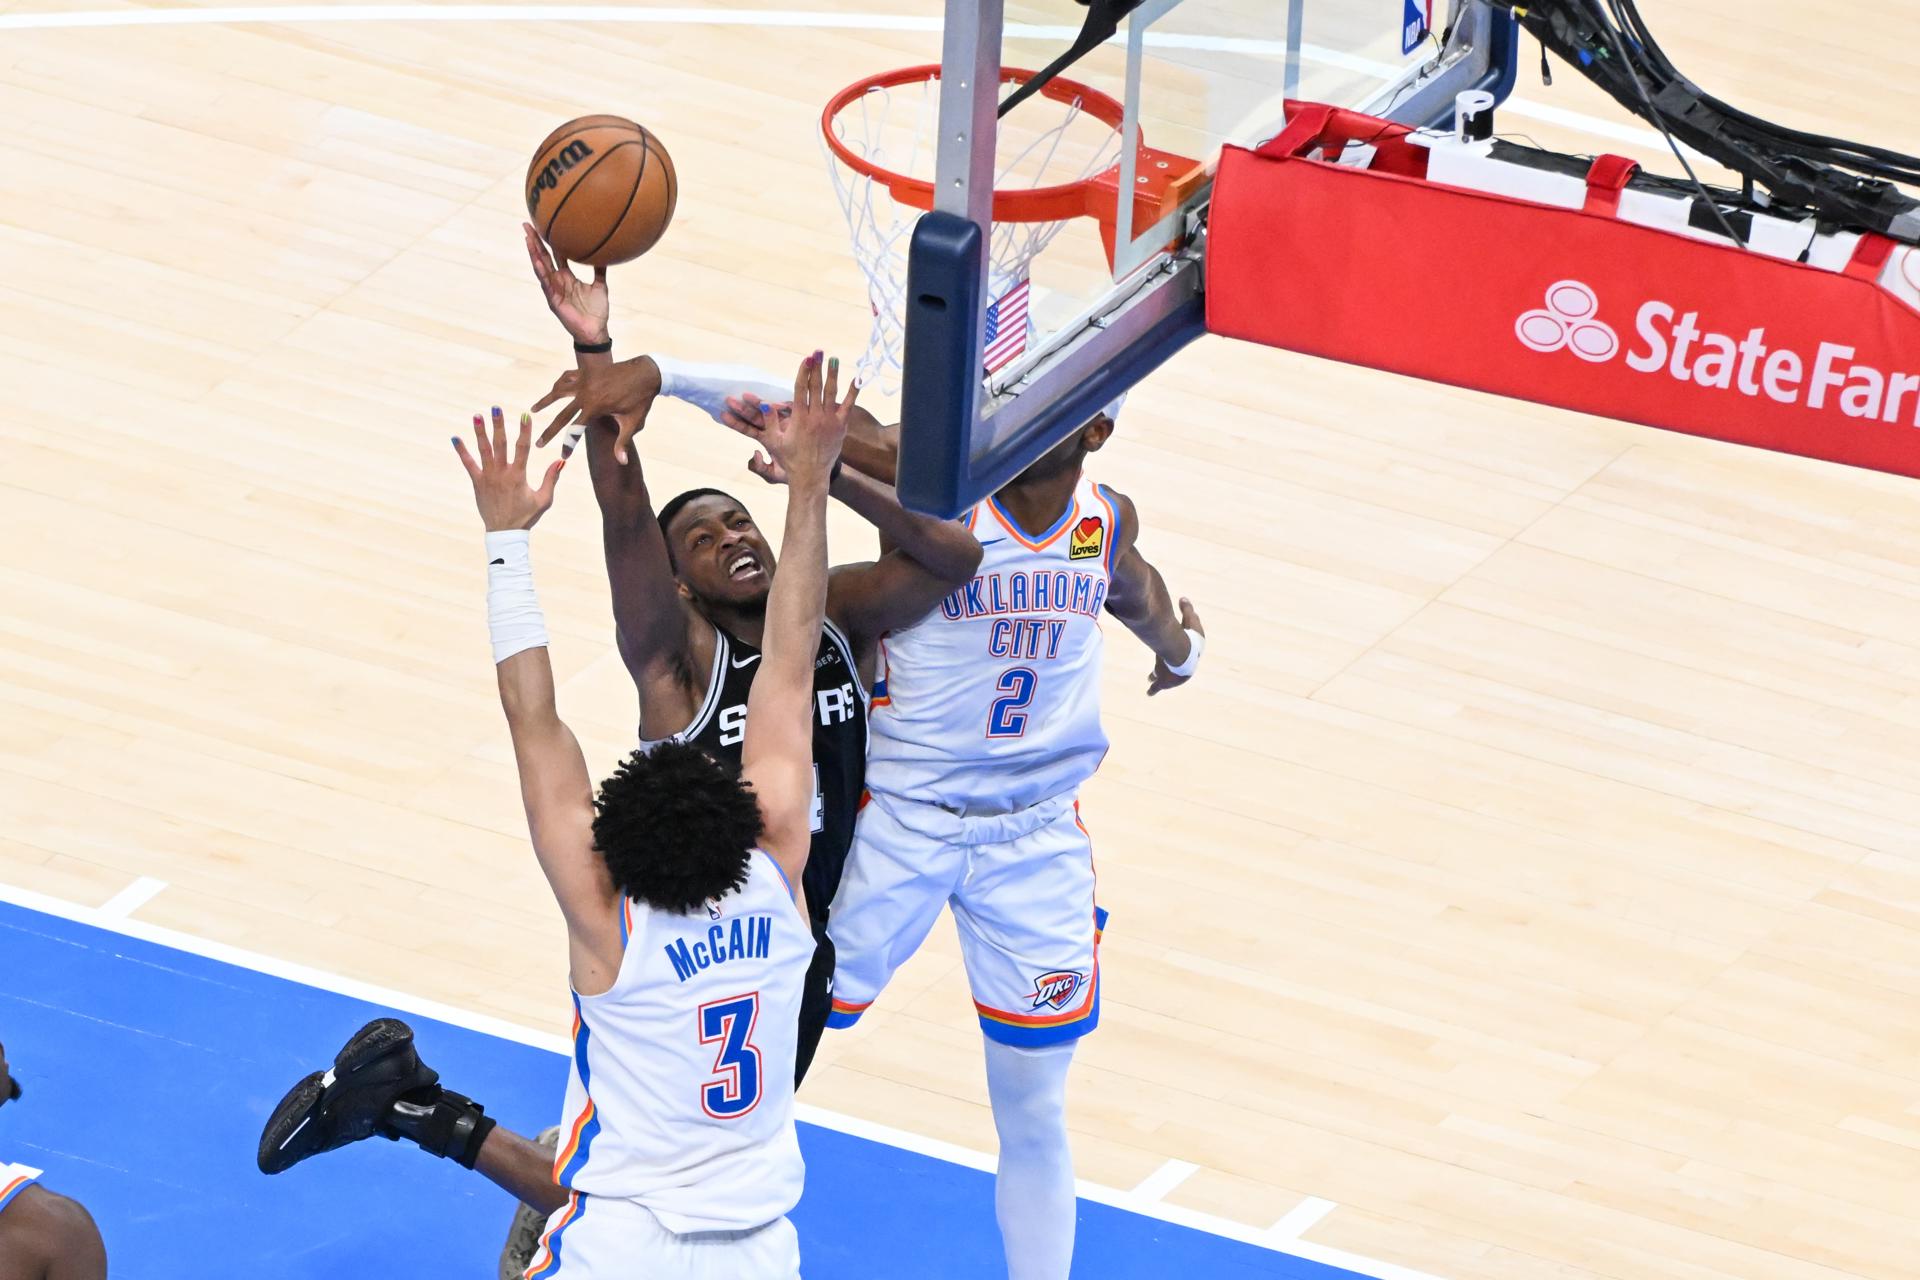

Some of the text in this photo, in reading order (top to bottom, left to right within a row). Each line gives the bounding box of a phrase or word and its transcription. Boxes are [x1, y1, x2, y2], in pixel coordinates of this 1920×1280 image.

[1806, 341, 1920, 428] Far
[988, 618, 1067, 660] CITY
[718, 682, 855, 747] SRS
[985, 666, 1038, 739] 2
[664, 916, 772, 983] McCAIN
[1033, 975, 1074, 1007] OKC
[698, 990, 763, 1120] 3
